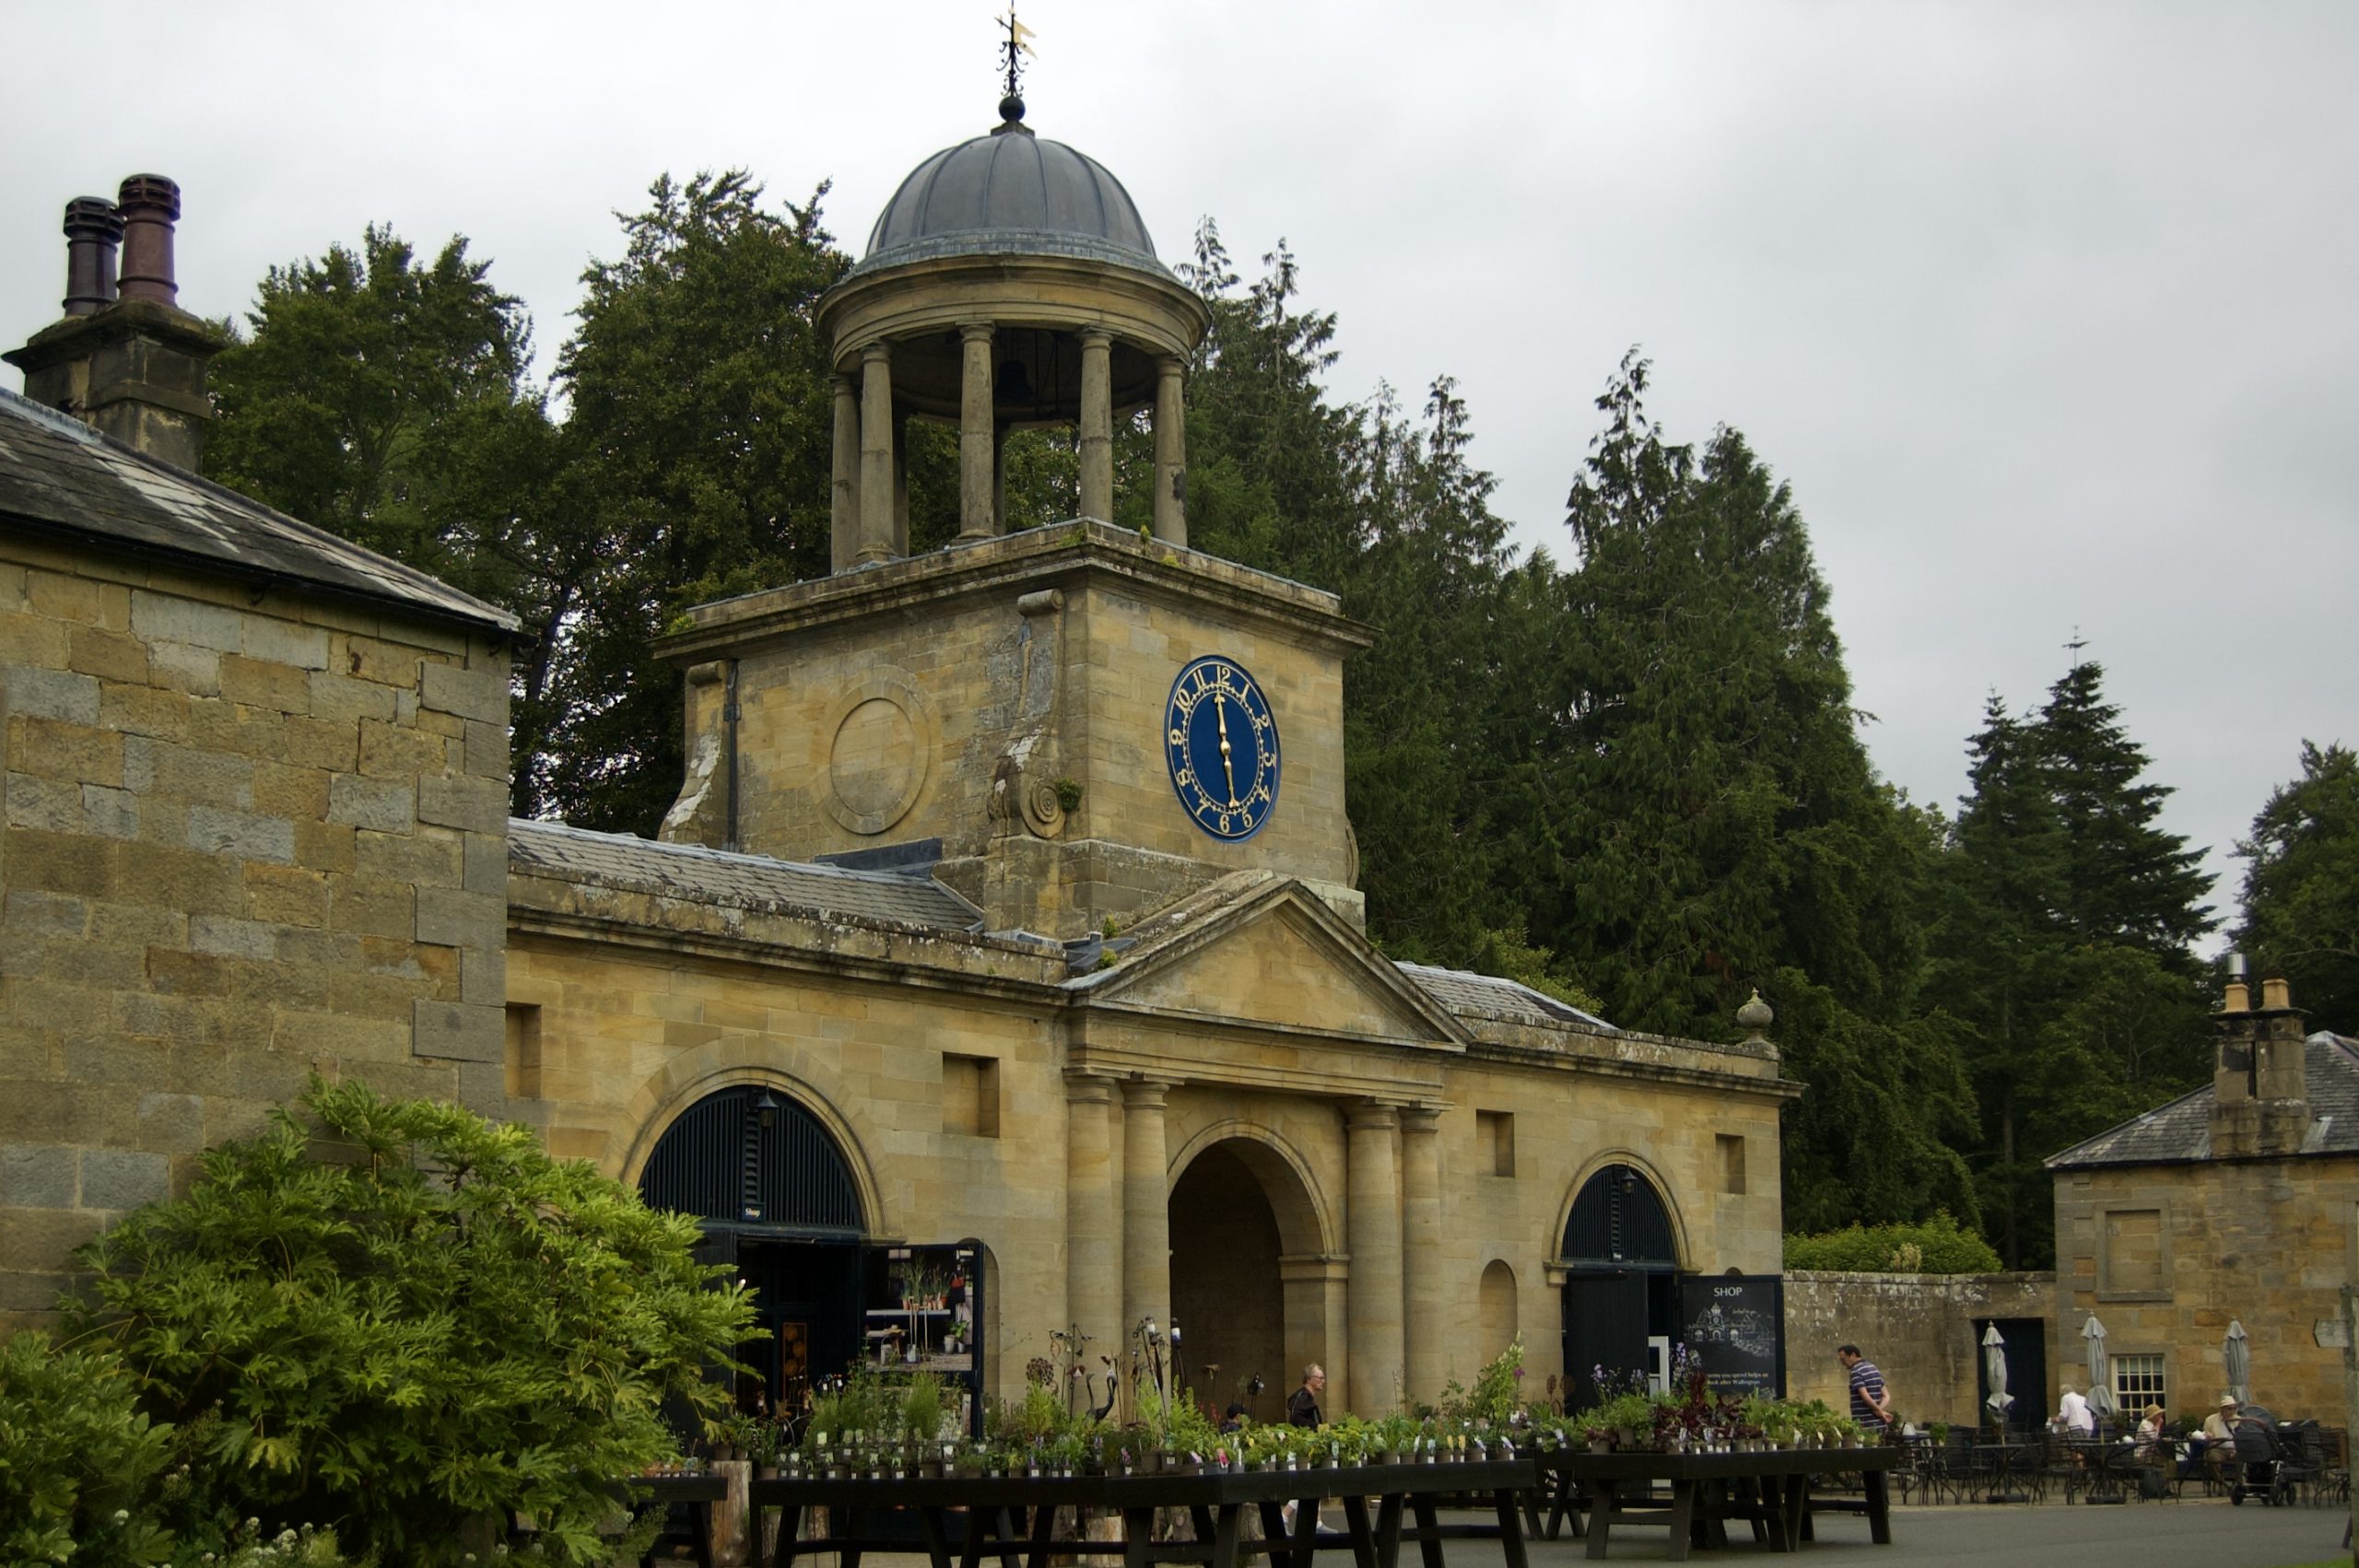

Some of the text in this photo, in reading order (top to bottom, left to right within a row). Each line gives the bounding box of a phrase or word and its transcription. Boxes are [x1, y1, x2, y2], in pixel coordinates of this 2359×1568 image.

[1192, 669, 1207, 690] 11
[1216, 665, 1231, 686] 12
[1175, 688, 1191, 713] 10
[1241, 683, 1250, 700] 1
[1256, 714, 1269, 731] 2
[1170, 729, 1182, 746] 9
[1263, 751, 1275, 767] 3
[1177, 768, 1191, 787] 8
[1258, 785, 1271, 803] 4
[1195, 798, 1209, 816] 7
[1219, 814, 1230, 834] 6
[1241, 810, 1253, 828] 5
[745, 1208, 760, 1218] Shop
[1714, 1286, 1743, 1297] SHOP
